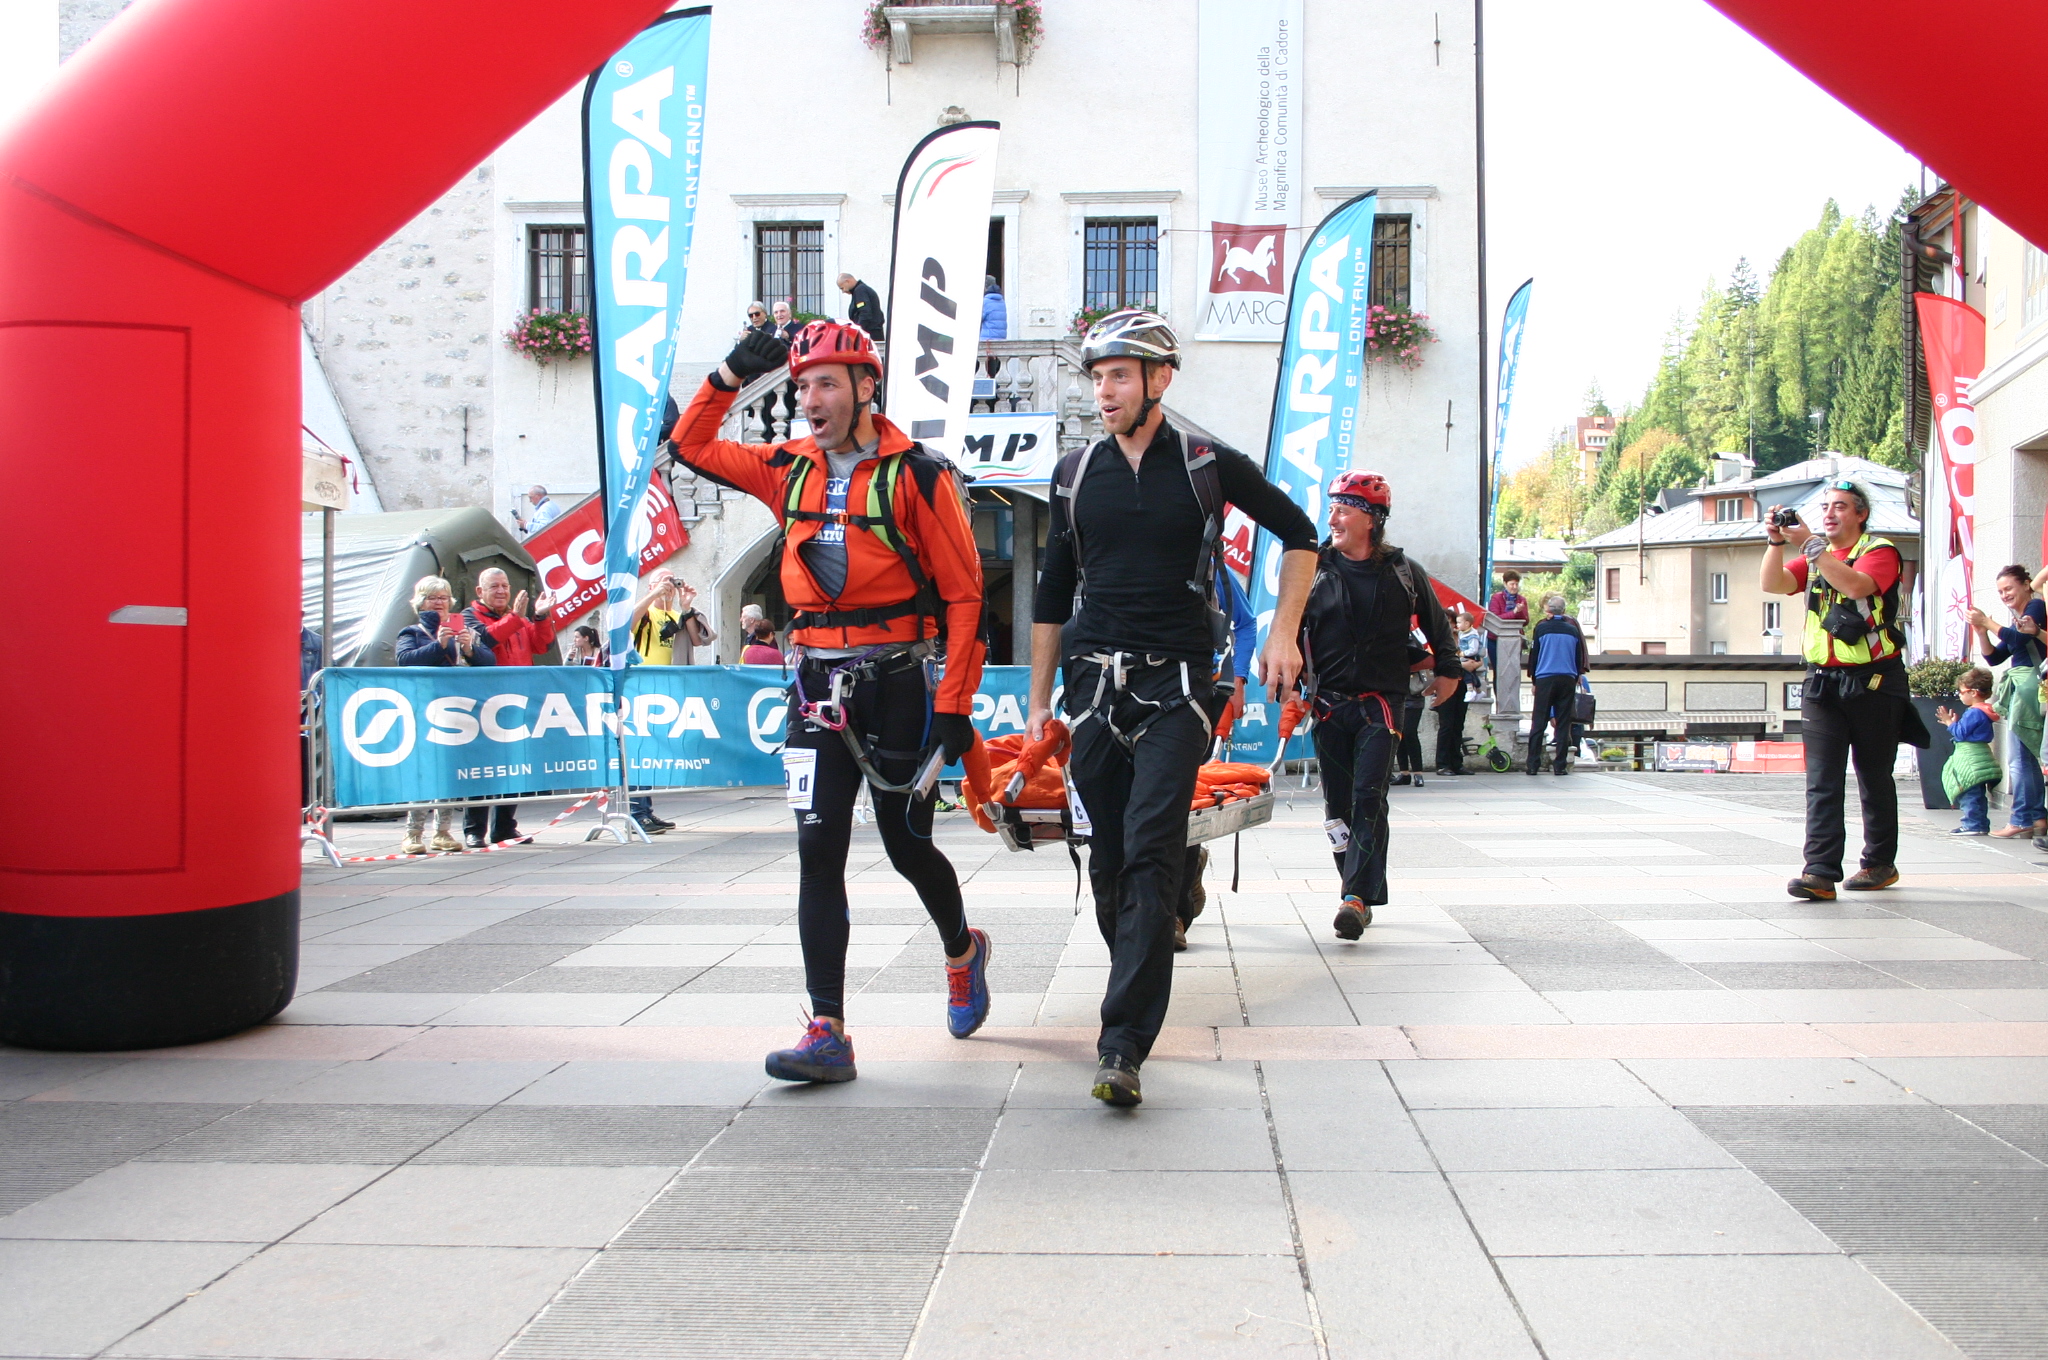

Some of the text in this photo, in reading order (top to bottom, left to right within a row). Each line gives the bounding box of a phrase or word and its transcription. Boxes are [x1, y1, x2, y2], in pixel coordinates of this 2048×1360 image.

[1255, 46, 1272, 211] Museo Archeologico della
[1273, 18, 1289, 211] Magnifica Comunità di Cadore
[1336, 406, 1354, 470] LUOGO
[556, 577, 608, 618] RESCUE
[457, 763, 532, 780] NESSUN
[545, 758, 598, 774] LUOGO
